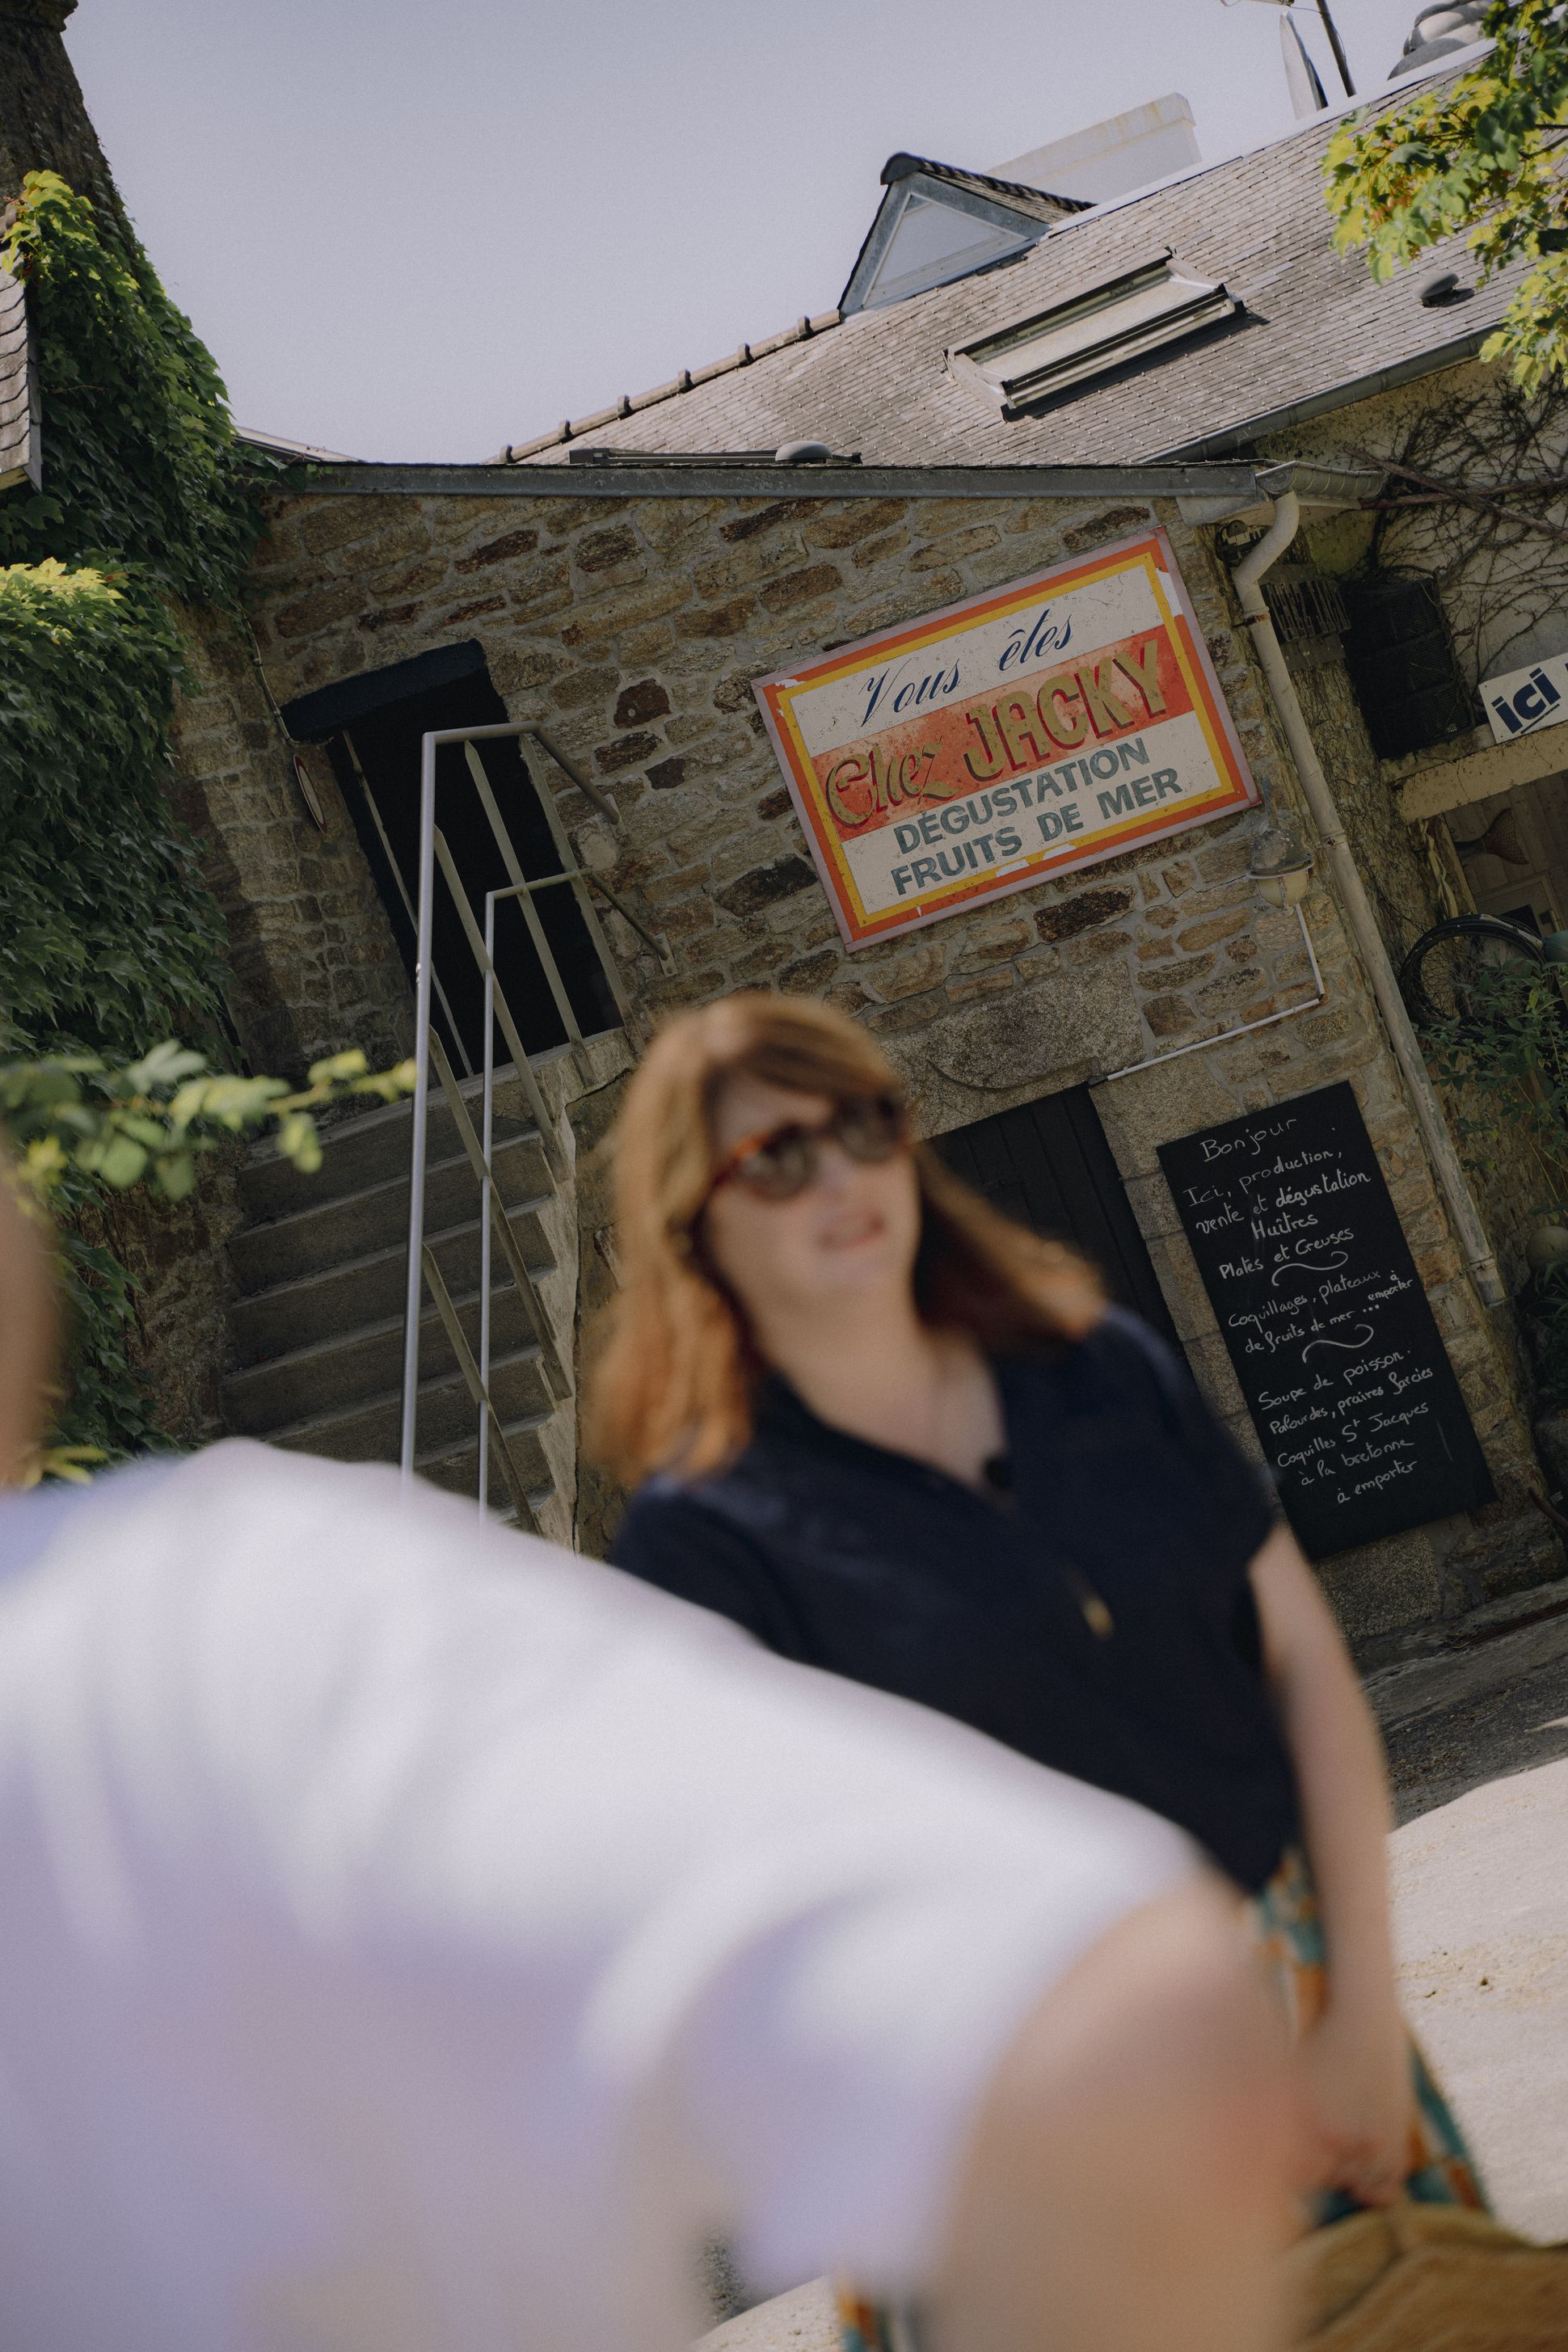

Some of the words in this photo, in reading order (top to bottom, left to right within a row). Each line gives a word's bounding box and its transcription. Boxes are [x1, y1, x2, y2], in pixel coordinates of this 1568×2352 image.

[859, 658, 960, 727] Vous
[998, 608, 1073, 672] êtes
[1491, 667, 1562, 734] ici
[825, 736, 962, 828] Chez
[964, 639, 1170, 782] JACKY
[894, 737, 1149, 854] DÉGUSTATION
[891, 826, 1022, 895] FRUITS
[1037, 803, 1083, 842] DE
[1097, 767, 1182, 820] MER
[1200, 1119, 1297, 1162] Bonjour
[1195, 1203, 1245, 1234] vente
[1253, 1195, 1267, 1215] et
[1275, 1169, 1371, 1208] dégustation
[1251, 1212, 1318, 1240] Huîtres
[1219, 1257, 1264, 1279] Plates
[1274, 1245, 1290, 1263] et
[1296, 1227, 1354, 1254] Creuses
[1390, 1271, 1399, 1281] à
[1319, 1271, 1381, 1305] plateaux
[1368, 1279, 1414, 1300] emporter
[1246, 1339, 1264, 1353] de
[1265, 1325, 1305, 1353] fruits
[1311, 1319, 1326, 1331] de
[1258, 1385, 1307, 1410] Soupe
[1313, 1375, 1334, 1391] de
[1338, 1386, 1384, 1415] praires
[1389, 1368, 1433, 1395] farcies
[1278, 1437, 1335, 1467] Coquilles
[1369, 1402, 1429, 1432] Jacques
[1299, 1471, 1314, 1486] à
[1317, 1460, 1335, 1478] la
[1342, 1439, 1414, 1467] bretonne
[1338, 1488, 1351, 1504] à
[1355, 1459, 1418, 1494] emporter
